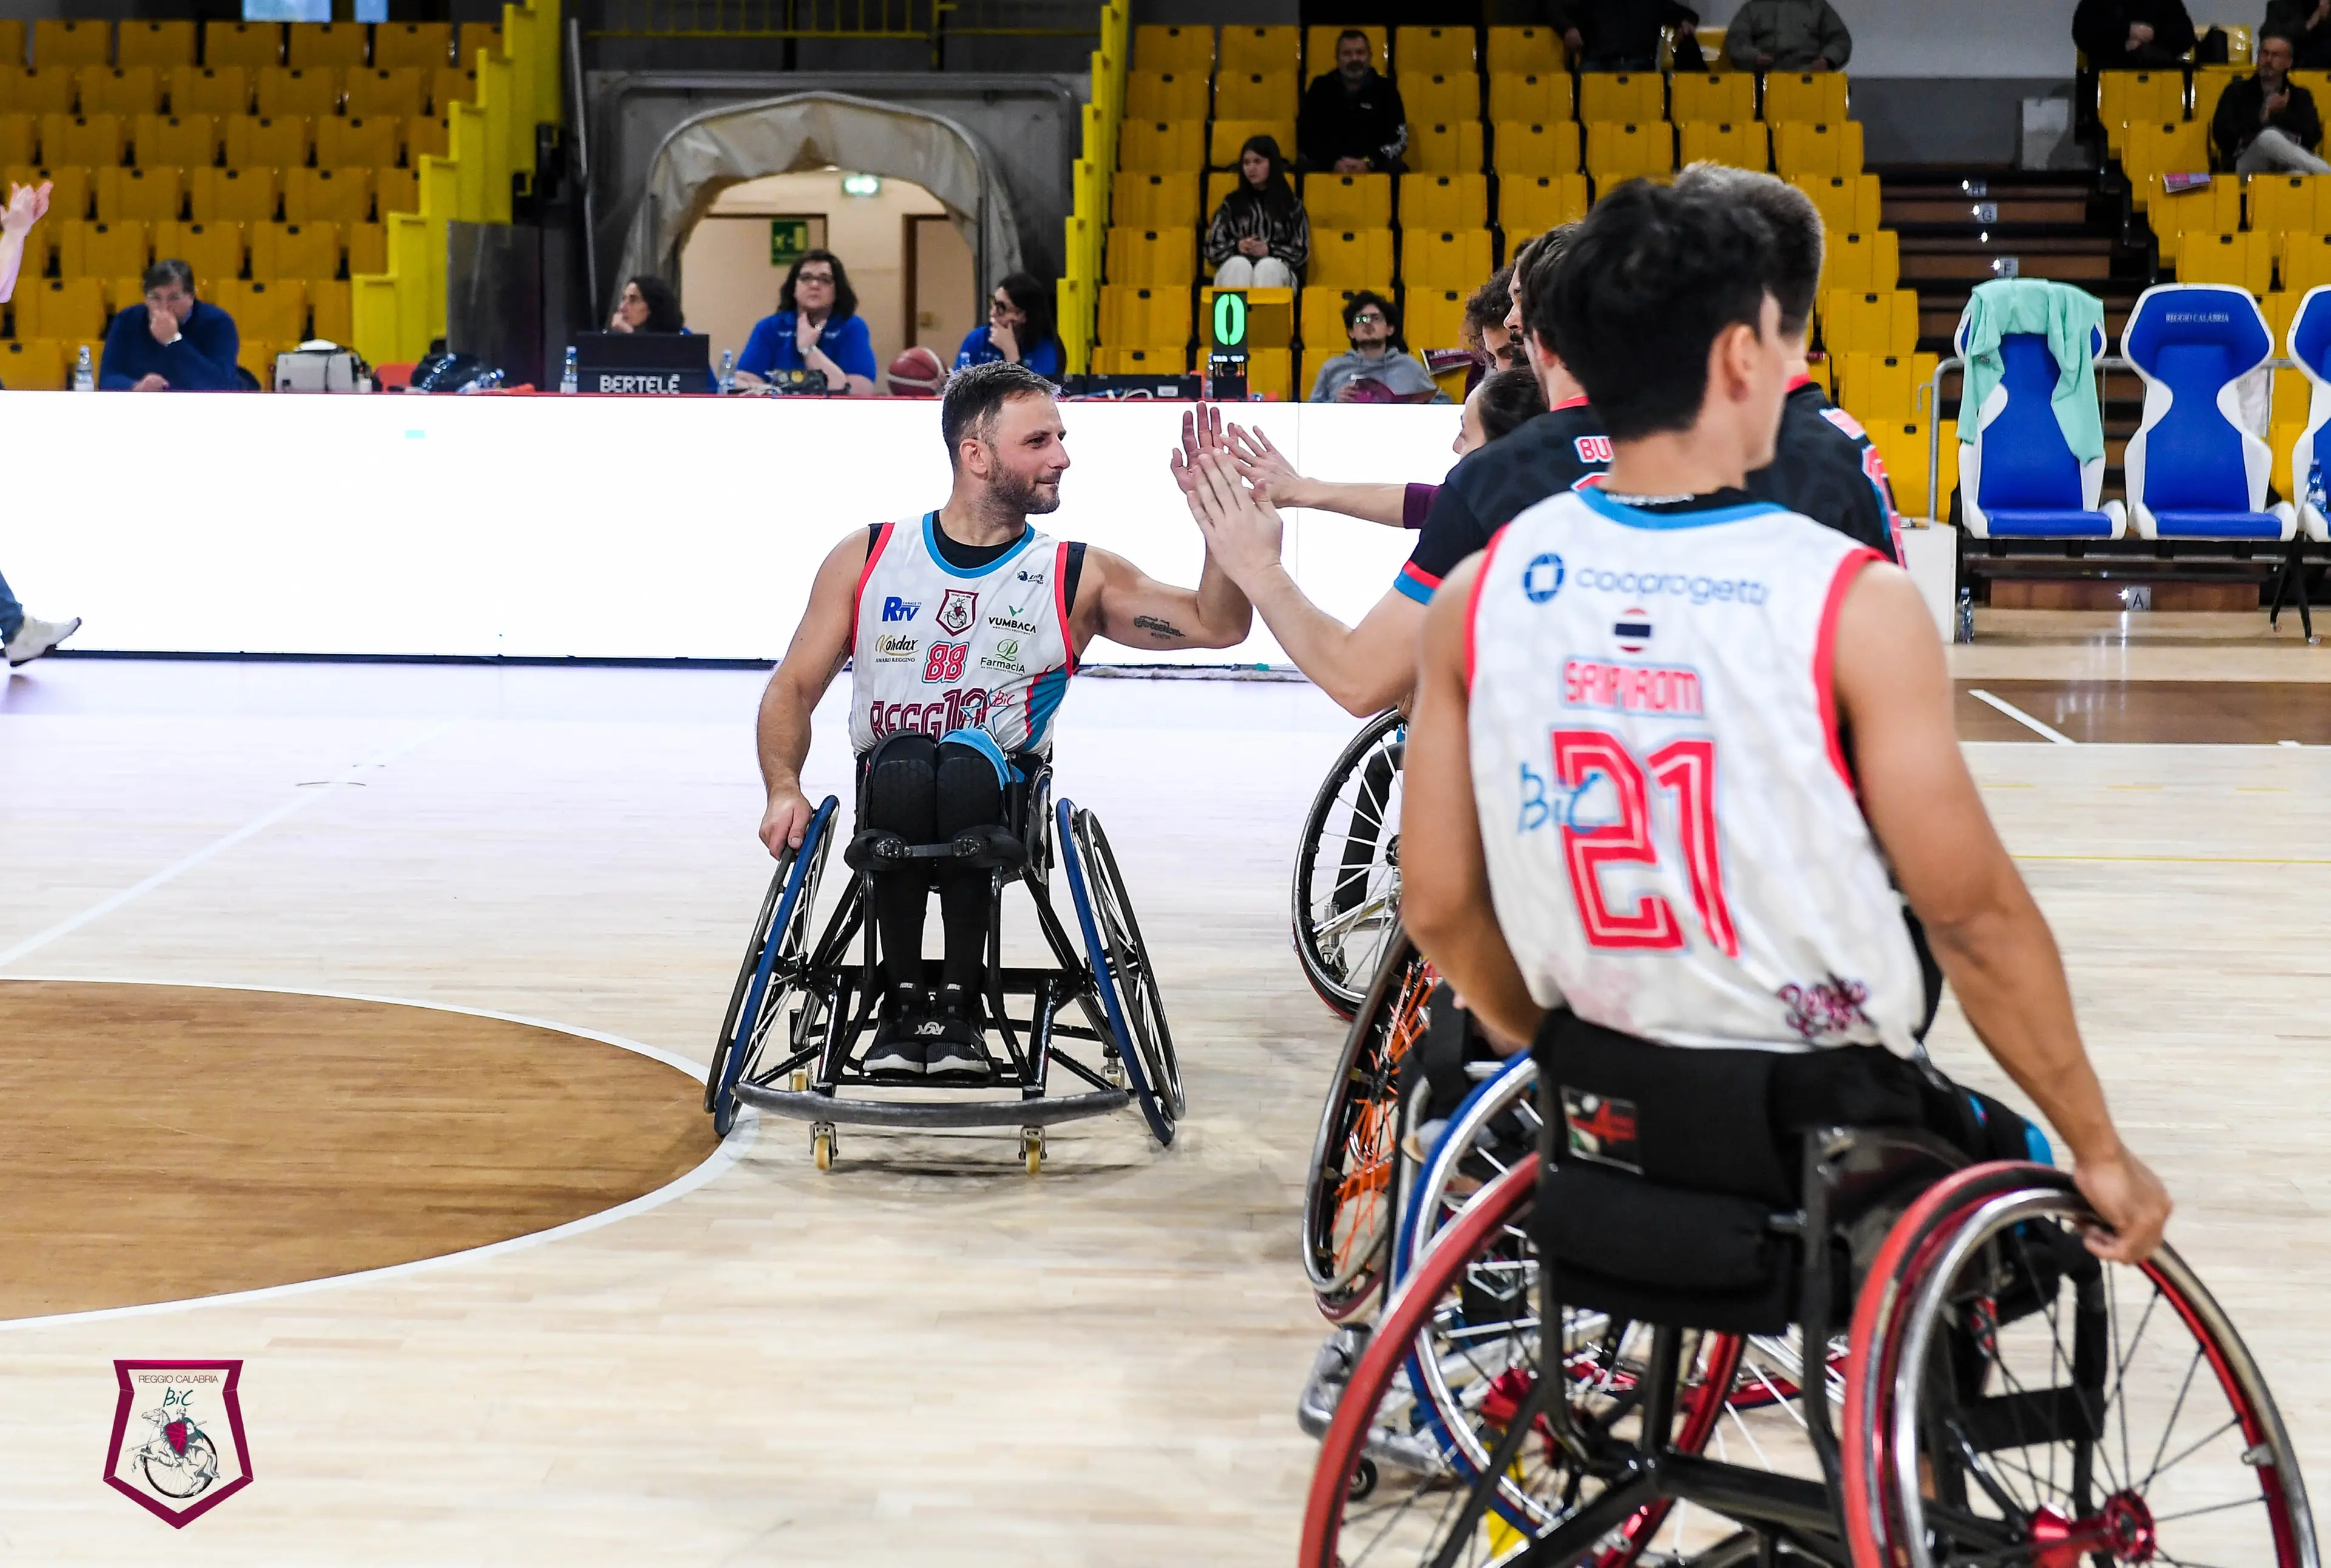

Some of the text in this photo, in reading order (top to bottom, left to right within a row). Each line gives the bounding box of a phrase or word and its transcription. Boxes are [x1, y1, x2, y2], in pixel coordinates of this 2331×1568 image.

[2003, 261, 2012, 275] F
[1215, 293, 1245, 346] 0
[2193, 312, 2230, 323] CALABRIA
[882, 597, 920, 622] RTV
[2132, 592, 2144, 609] A
[988, 617, 1036, 634] VUMBACA
[922, 642, 969, 683] 88
[1550, 730, 1740, 960] 21
